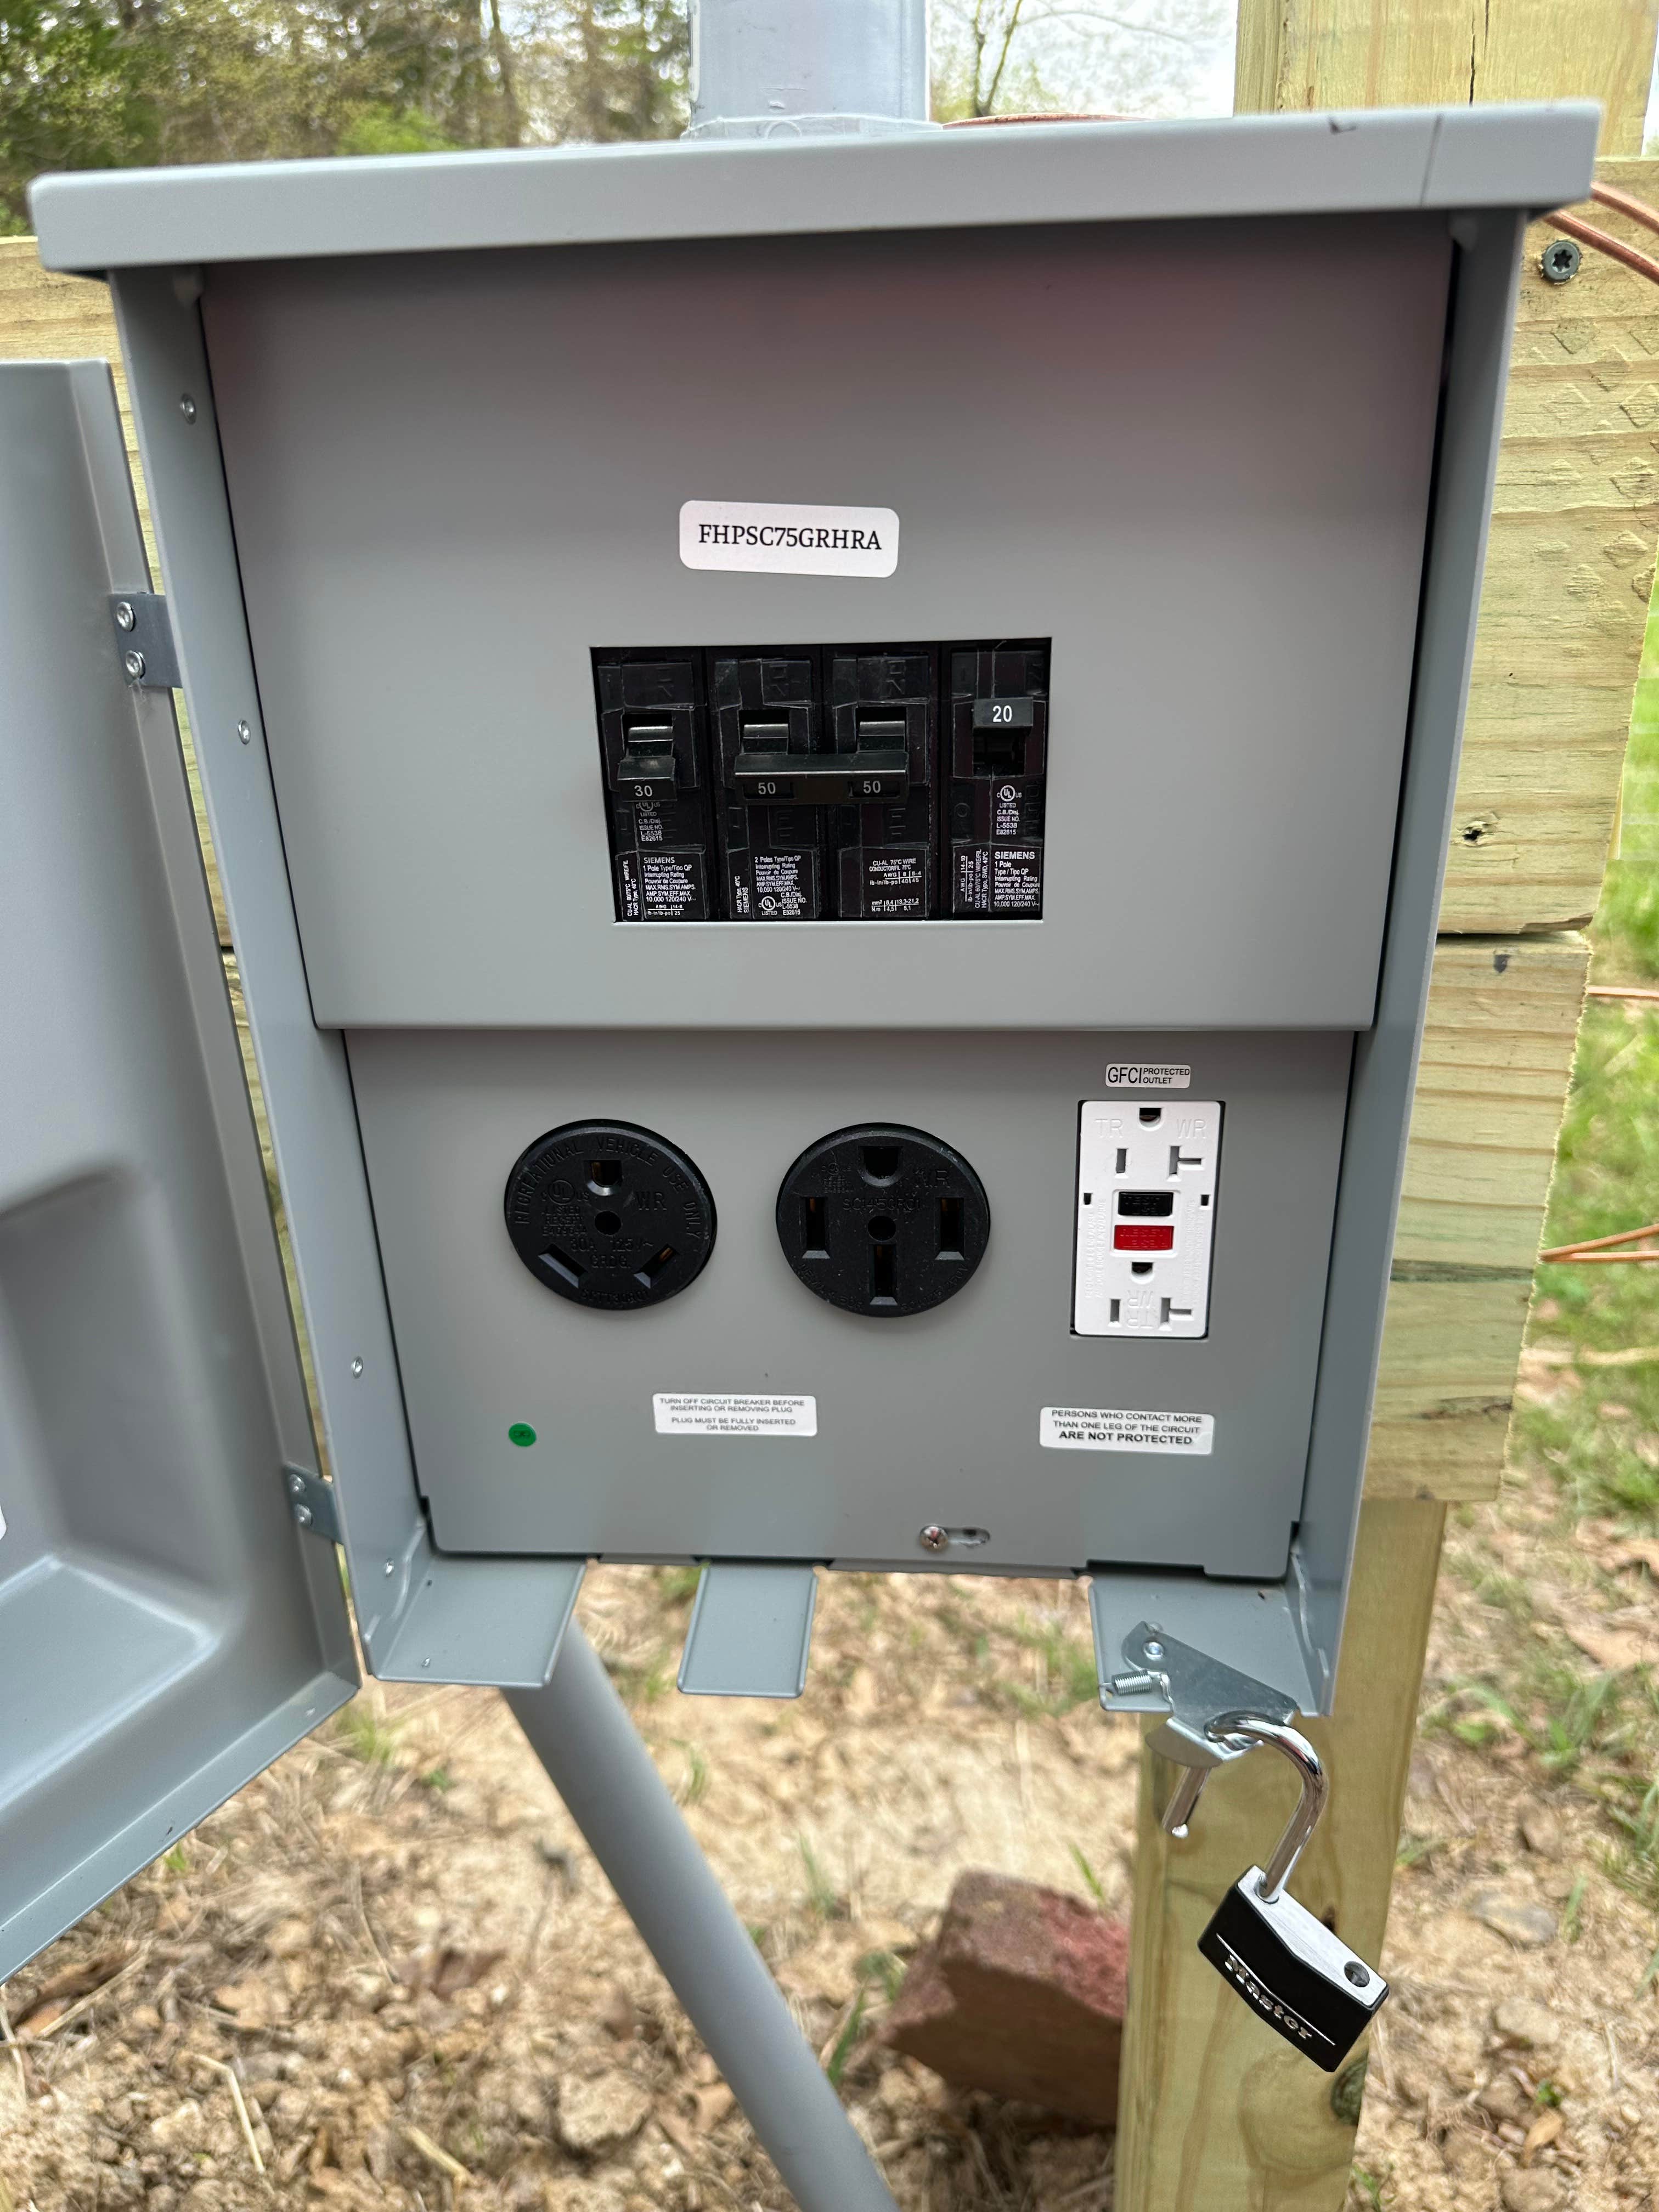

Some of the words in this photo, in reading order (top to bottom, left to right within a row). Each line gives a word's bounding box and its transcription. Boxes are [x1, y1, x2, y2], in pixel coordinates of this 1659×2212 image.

[699, 524, 882, 550] FHPSC75GRHRA
[992, 705, 1013, 723] 20
[634, 785, 652, 797] 30
[758, 782, 776, 795] 50
[862, 781, 881, 794] 50
[995, 851, 1035, 860] SIEMENS
[1108, 1066, 1142, 1084] GFCI
[1143, 1068, 1190, 1076] PROTECTED
[1095, 1119, 1124, 1138] TR
[1177, 1119, 1207, 1139] WR
[1052, 1409, 1097, 1418] PERSONS
[1126, 1413, 1171, 1421] CONTACT
[1054, 1420, 1078, 1428] THAN
[1161, 1425, 1200, 1434] CIRCUIT
[1059, 1431, 1084, 1439] ARE
[1088, 1432, 1113, 1441] NOT
[1117, 1434, 1192, 1444] PROTECTED
[1224, 1954, 1312, 2040] Master
